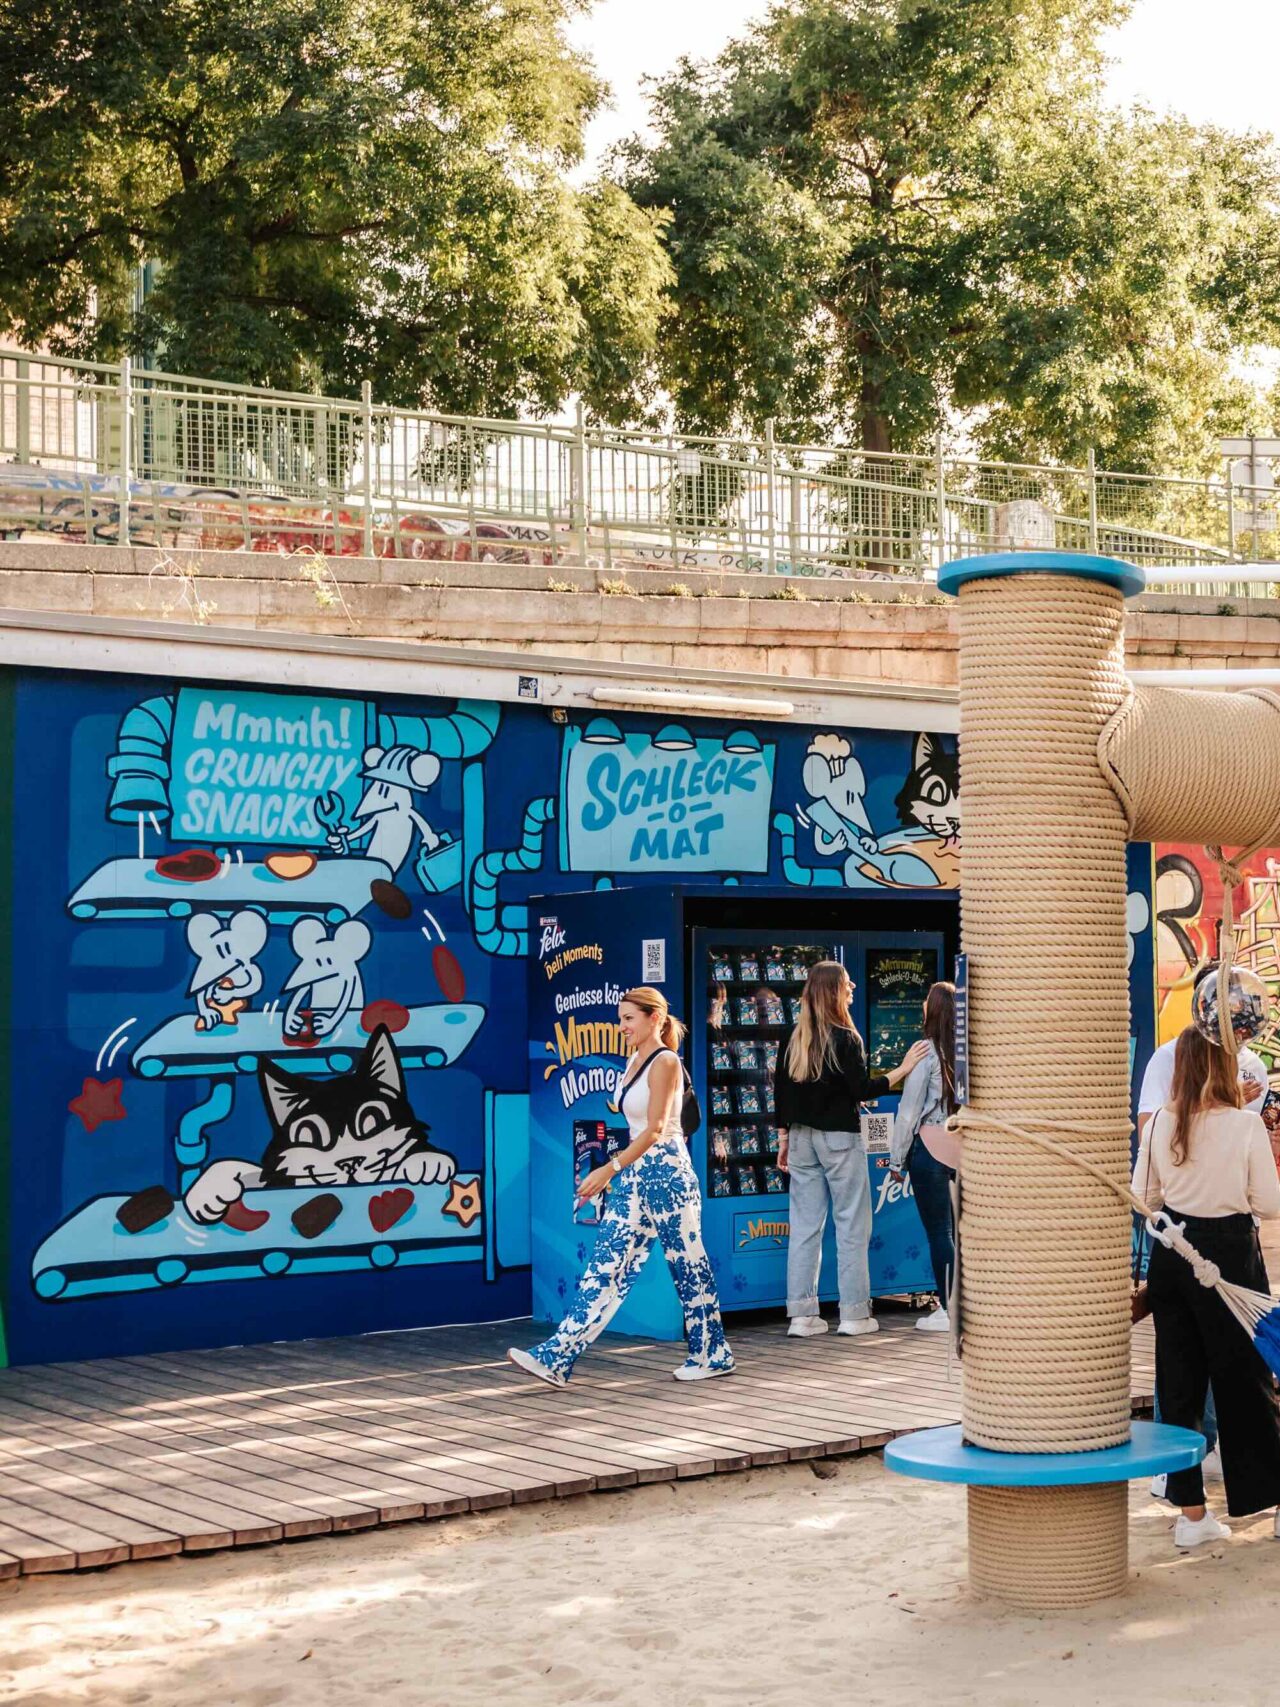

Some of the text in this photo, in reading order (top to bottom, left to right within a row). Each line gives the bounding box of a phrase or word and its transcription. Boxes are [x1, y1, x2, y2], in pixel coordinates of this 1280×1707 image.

[192, 700, 352, 749] Mmmh!
[184, 748, 358, 791] CRUNCHY
[581, 752, 763, 832] SCHLECK
[629, 813, 724, 861] MAT
[539, 924, 566, 960] felix
[563, 943, 603, 966] Moments
[555, 986, 603, 1014] Geniesse
